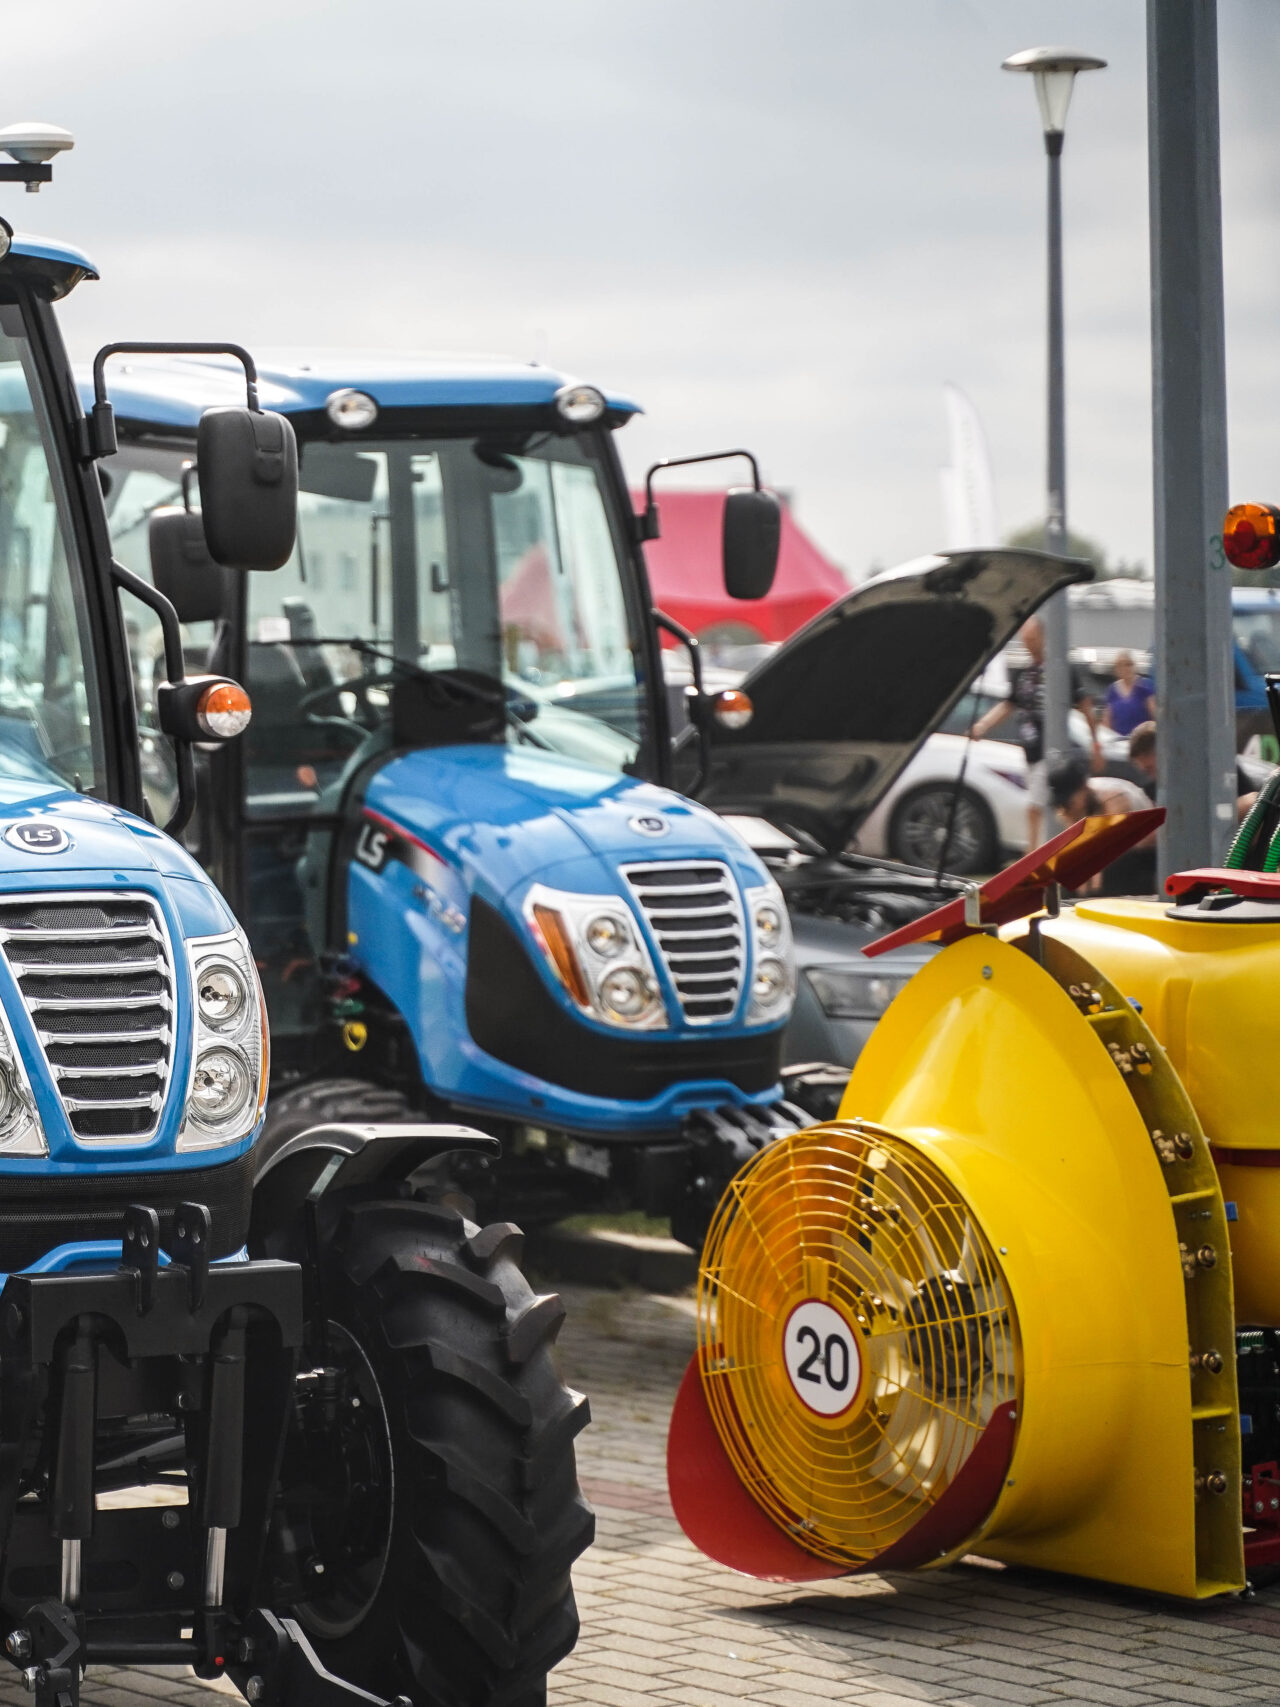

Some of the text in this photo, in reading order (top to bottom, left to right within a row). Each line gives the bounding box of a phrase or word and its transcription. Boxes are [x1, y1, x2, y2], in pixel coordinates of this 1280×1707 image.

[23, 830, 54, 842] LS
[356, 824, 388, 868] LS
[796, 1325, 849, 1392] 20
